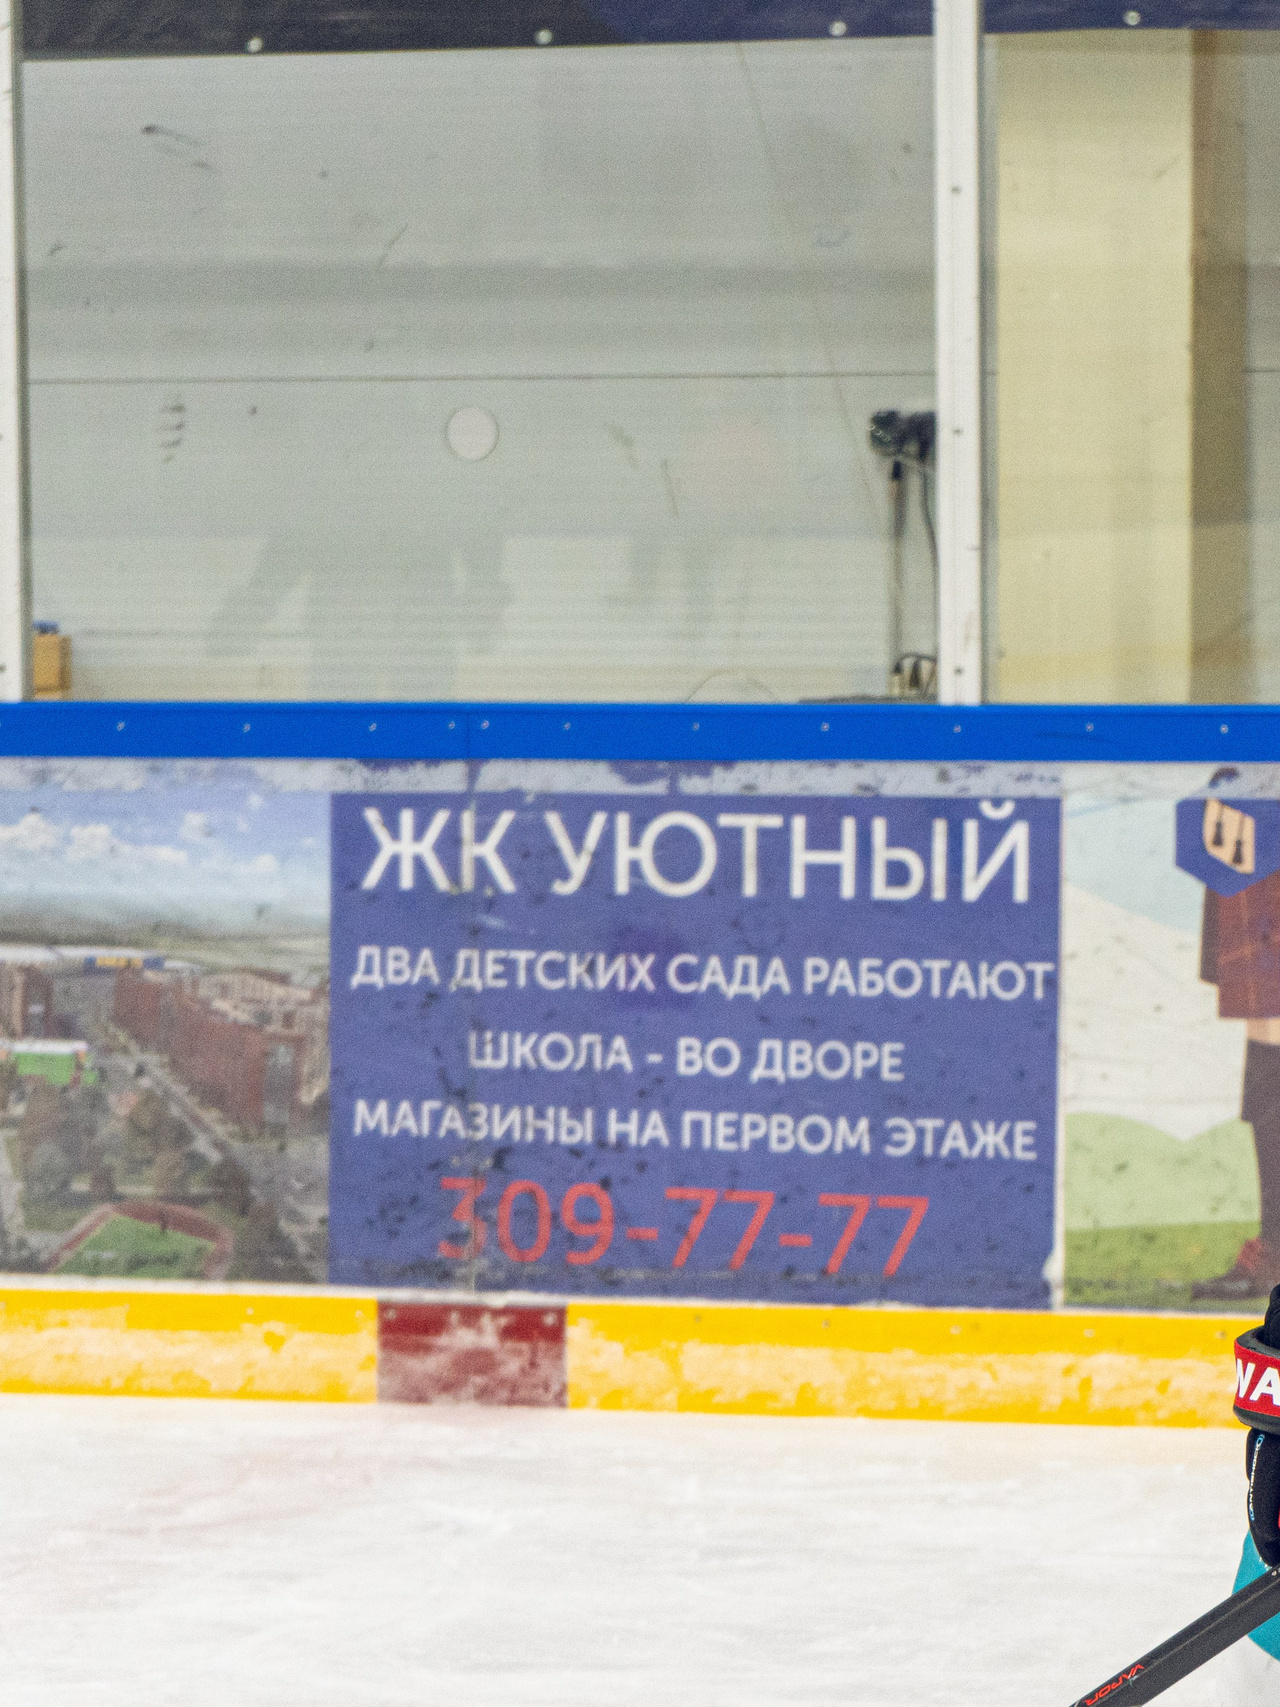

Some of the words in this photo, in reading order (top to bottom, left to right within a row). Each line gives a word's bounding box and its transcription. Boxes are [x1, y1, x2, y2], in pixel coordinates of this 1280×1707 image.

[362, 807, 517, 893] ЖК
[545, 800, 1030, 902] УЮТНЫЙ
[351, 946, 439, 990] ДВА
[450, 949, 656, 992] ДЕТСКИХ
[667, 954, 791, 1000] САДА
[804, 957, 1054, 1001] РАБОТАЮТ
[469, 1031, 633, 1073] ШКОЛА
[676, 1036, 742, 1077] ВО
[750, 1039, 905, 1082] ДВОРЕ
[353, 1098, 594, 1144] МАГАЗИНЫ
[607, 1108, 670, 1146] НА
[681, 1110, 871, 1155] ПЕРВОМ
[884, 1116, 1038, 1160] ЭТАЖЕ
[438, 1176, 930, 1276] 309-77-77
